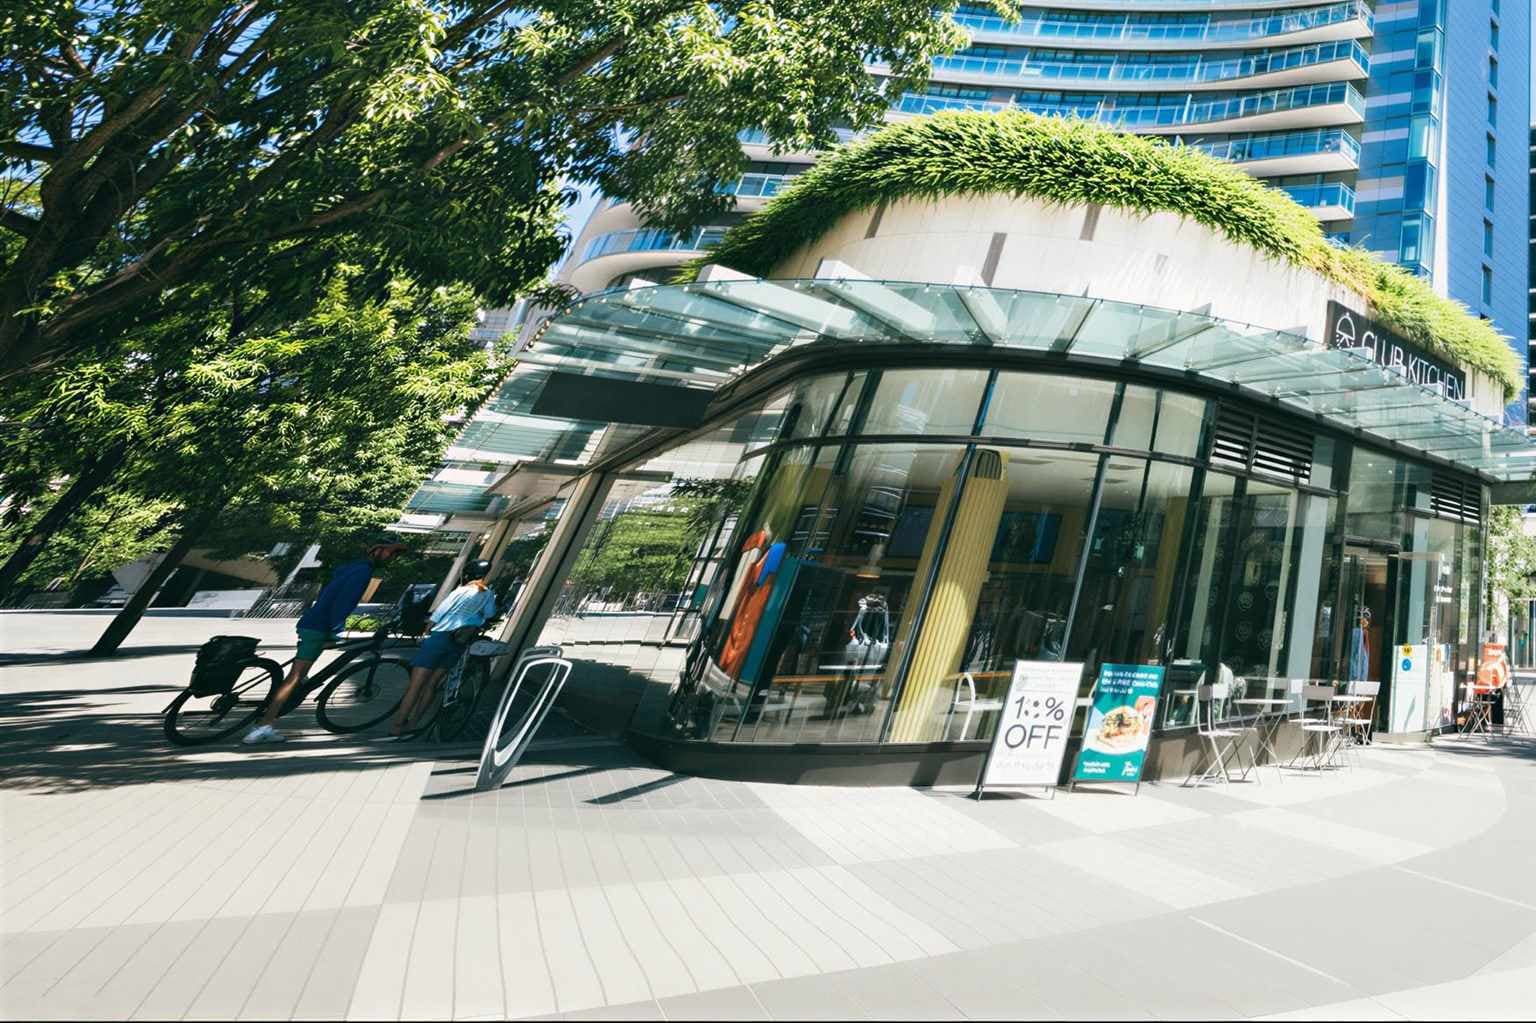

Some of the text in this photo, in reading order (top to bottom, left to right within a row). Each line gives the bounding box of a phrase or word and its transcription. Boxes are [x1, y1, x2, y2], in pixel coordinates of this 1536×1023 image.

[1362, 331, 1465, 401] CLUB KITCHEN
[1004, 723, 1063, 750] OFF
